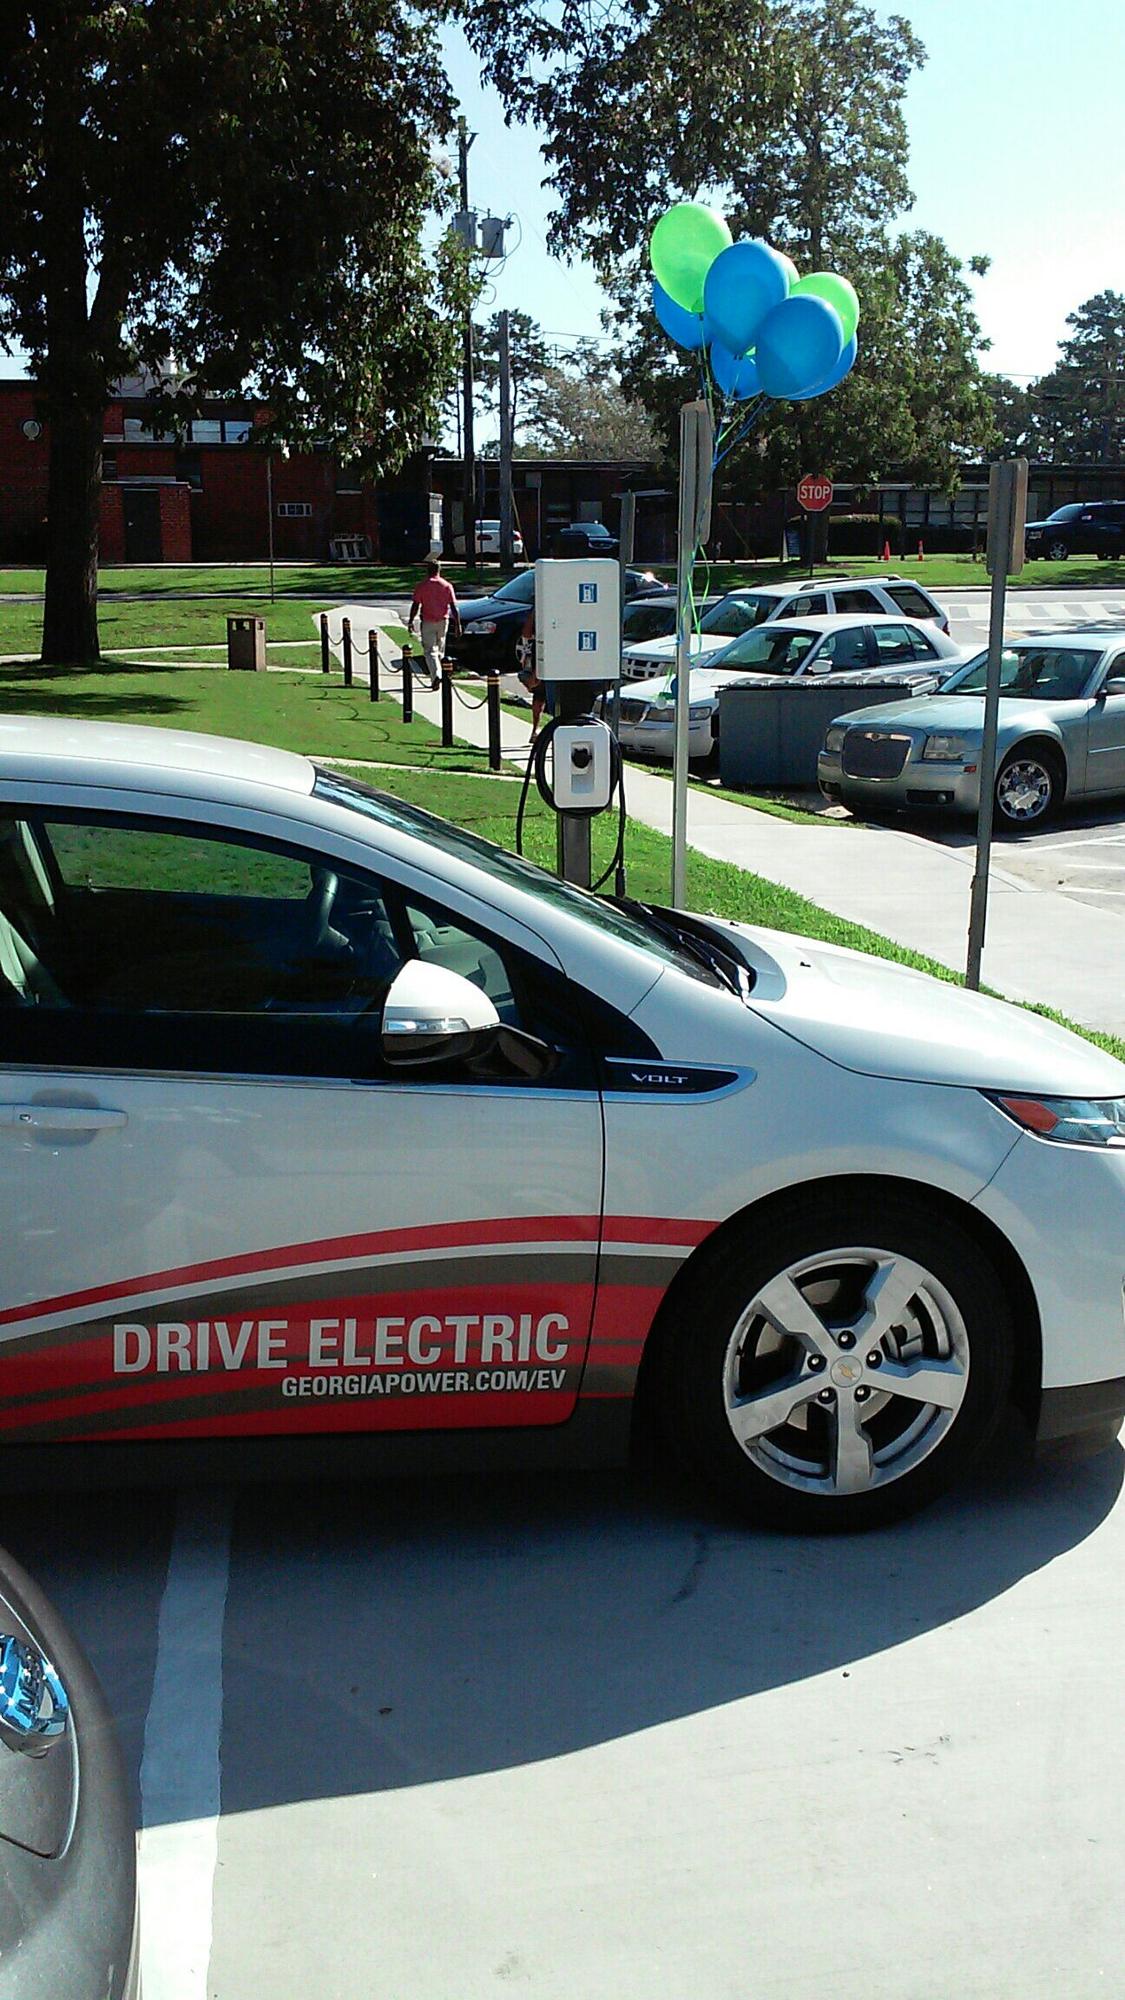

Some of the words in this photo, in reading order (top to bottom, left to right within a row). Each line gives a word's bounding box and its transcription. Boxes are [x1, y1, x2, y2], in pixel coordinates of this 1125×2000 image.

[800, 485, 831, 500] STOP
[631, 1073, 689, 1084] VOLT
[113, 1320, 288, 1373] DRIVE
[308, 1313, 570, 1368] ELECTRIC
[281, 1369, 567, 1397] GEORGIAPOWER.COM/EV
